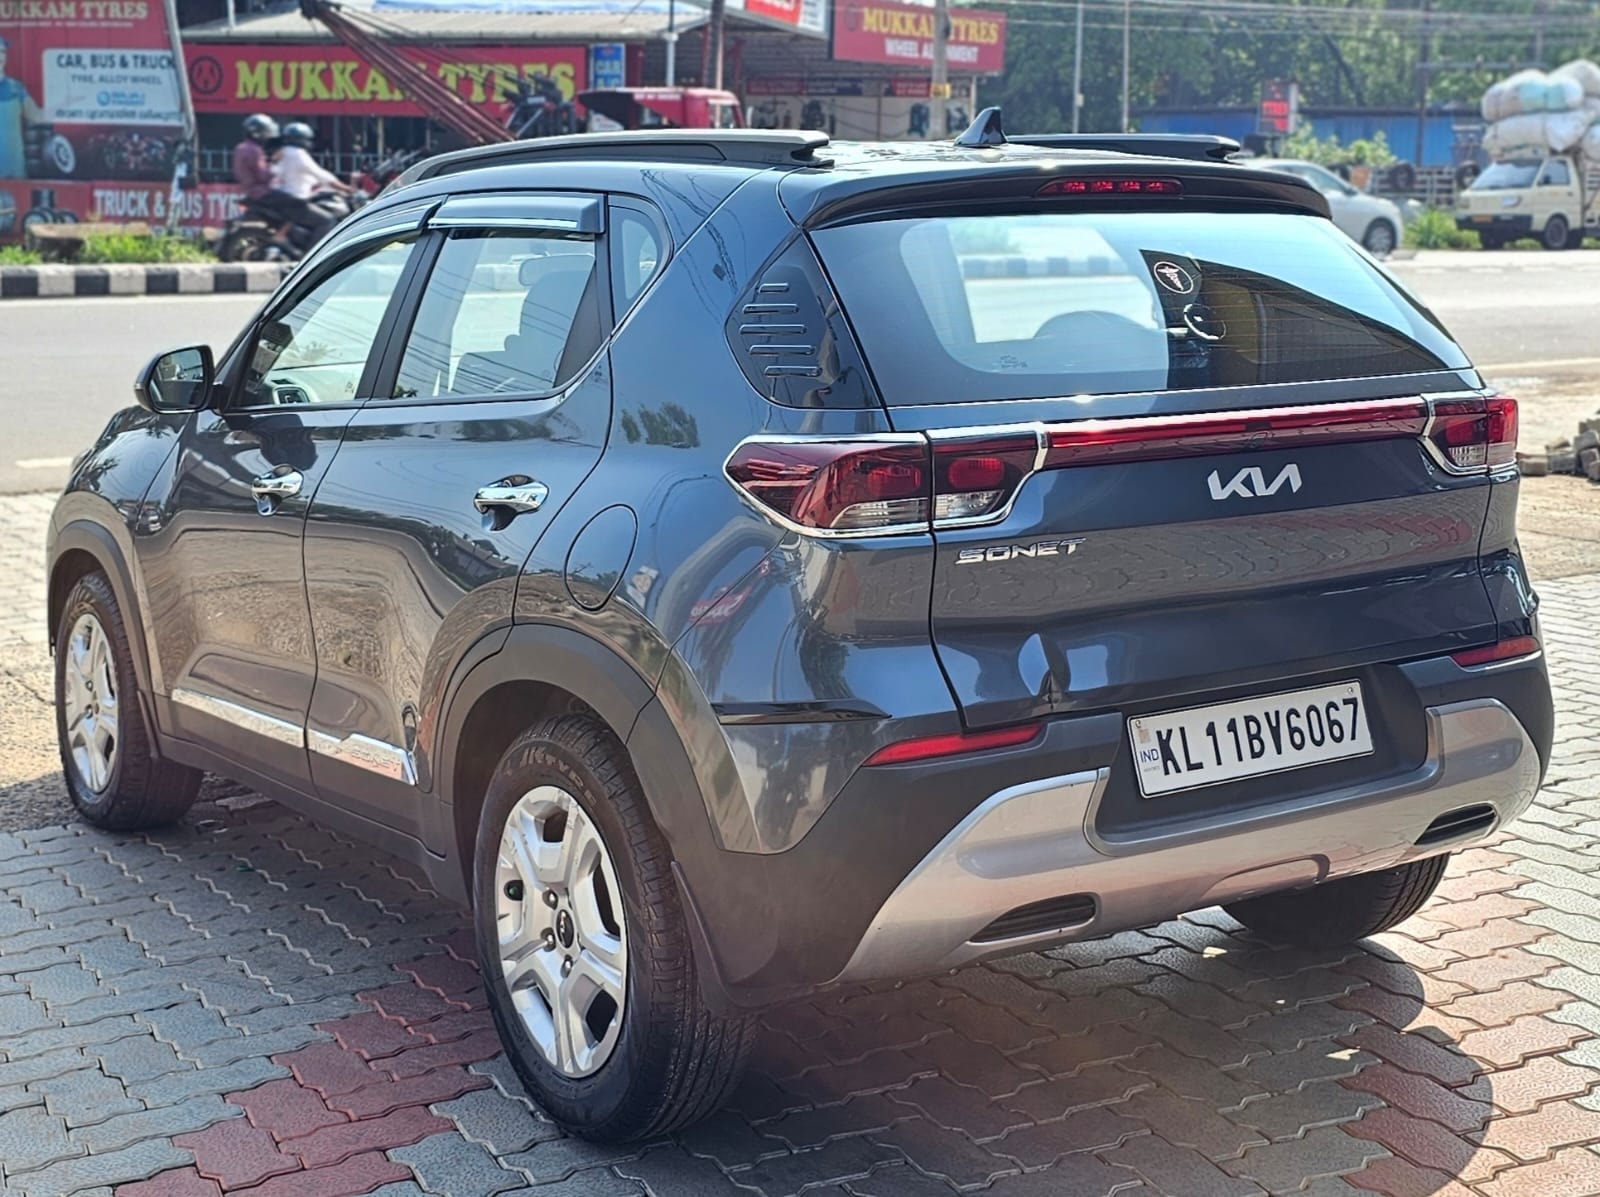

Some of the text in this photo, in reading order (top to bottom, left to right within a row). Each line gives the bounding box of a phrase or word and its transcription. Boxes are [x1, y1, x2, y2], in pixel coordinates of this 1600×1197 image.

[81, 1, 148, 19] TYRES
[862, 8, 999, 44] MUKKA TYRES
[56, 54, 87, 70] CAR,
[90, 54, 116, 69] BUS
[119, 55, 129, 69] &
[884, 38, 920, 58] WHEEL
[98, 74, 129, 84] ALLOY
[130, 75, 163, 85] WHEEL
[235, 60, 427, 102] MUKKA
[93, 188, 247, 221] TRUCK & US TYR
[1207, 463, 1303, 501] KIA
[955, 537, 1087, 565] SONET
[1155, 697, 1359, 777] KL11BV6067
[1140, 748, 1160, 763] IND
